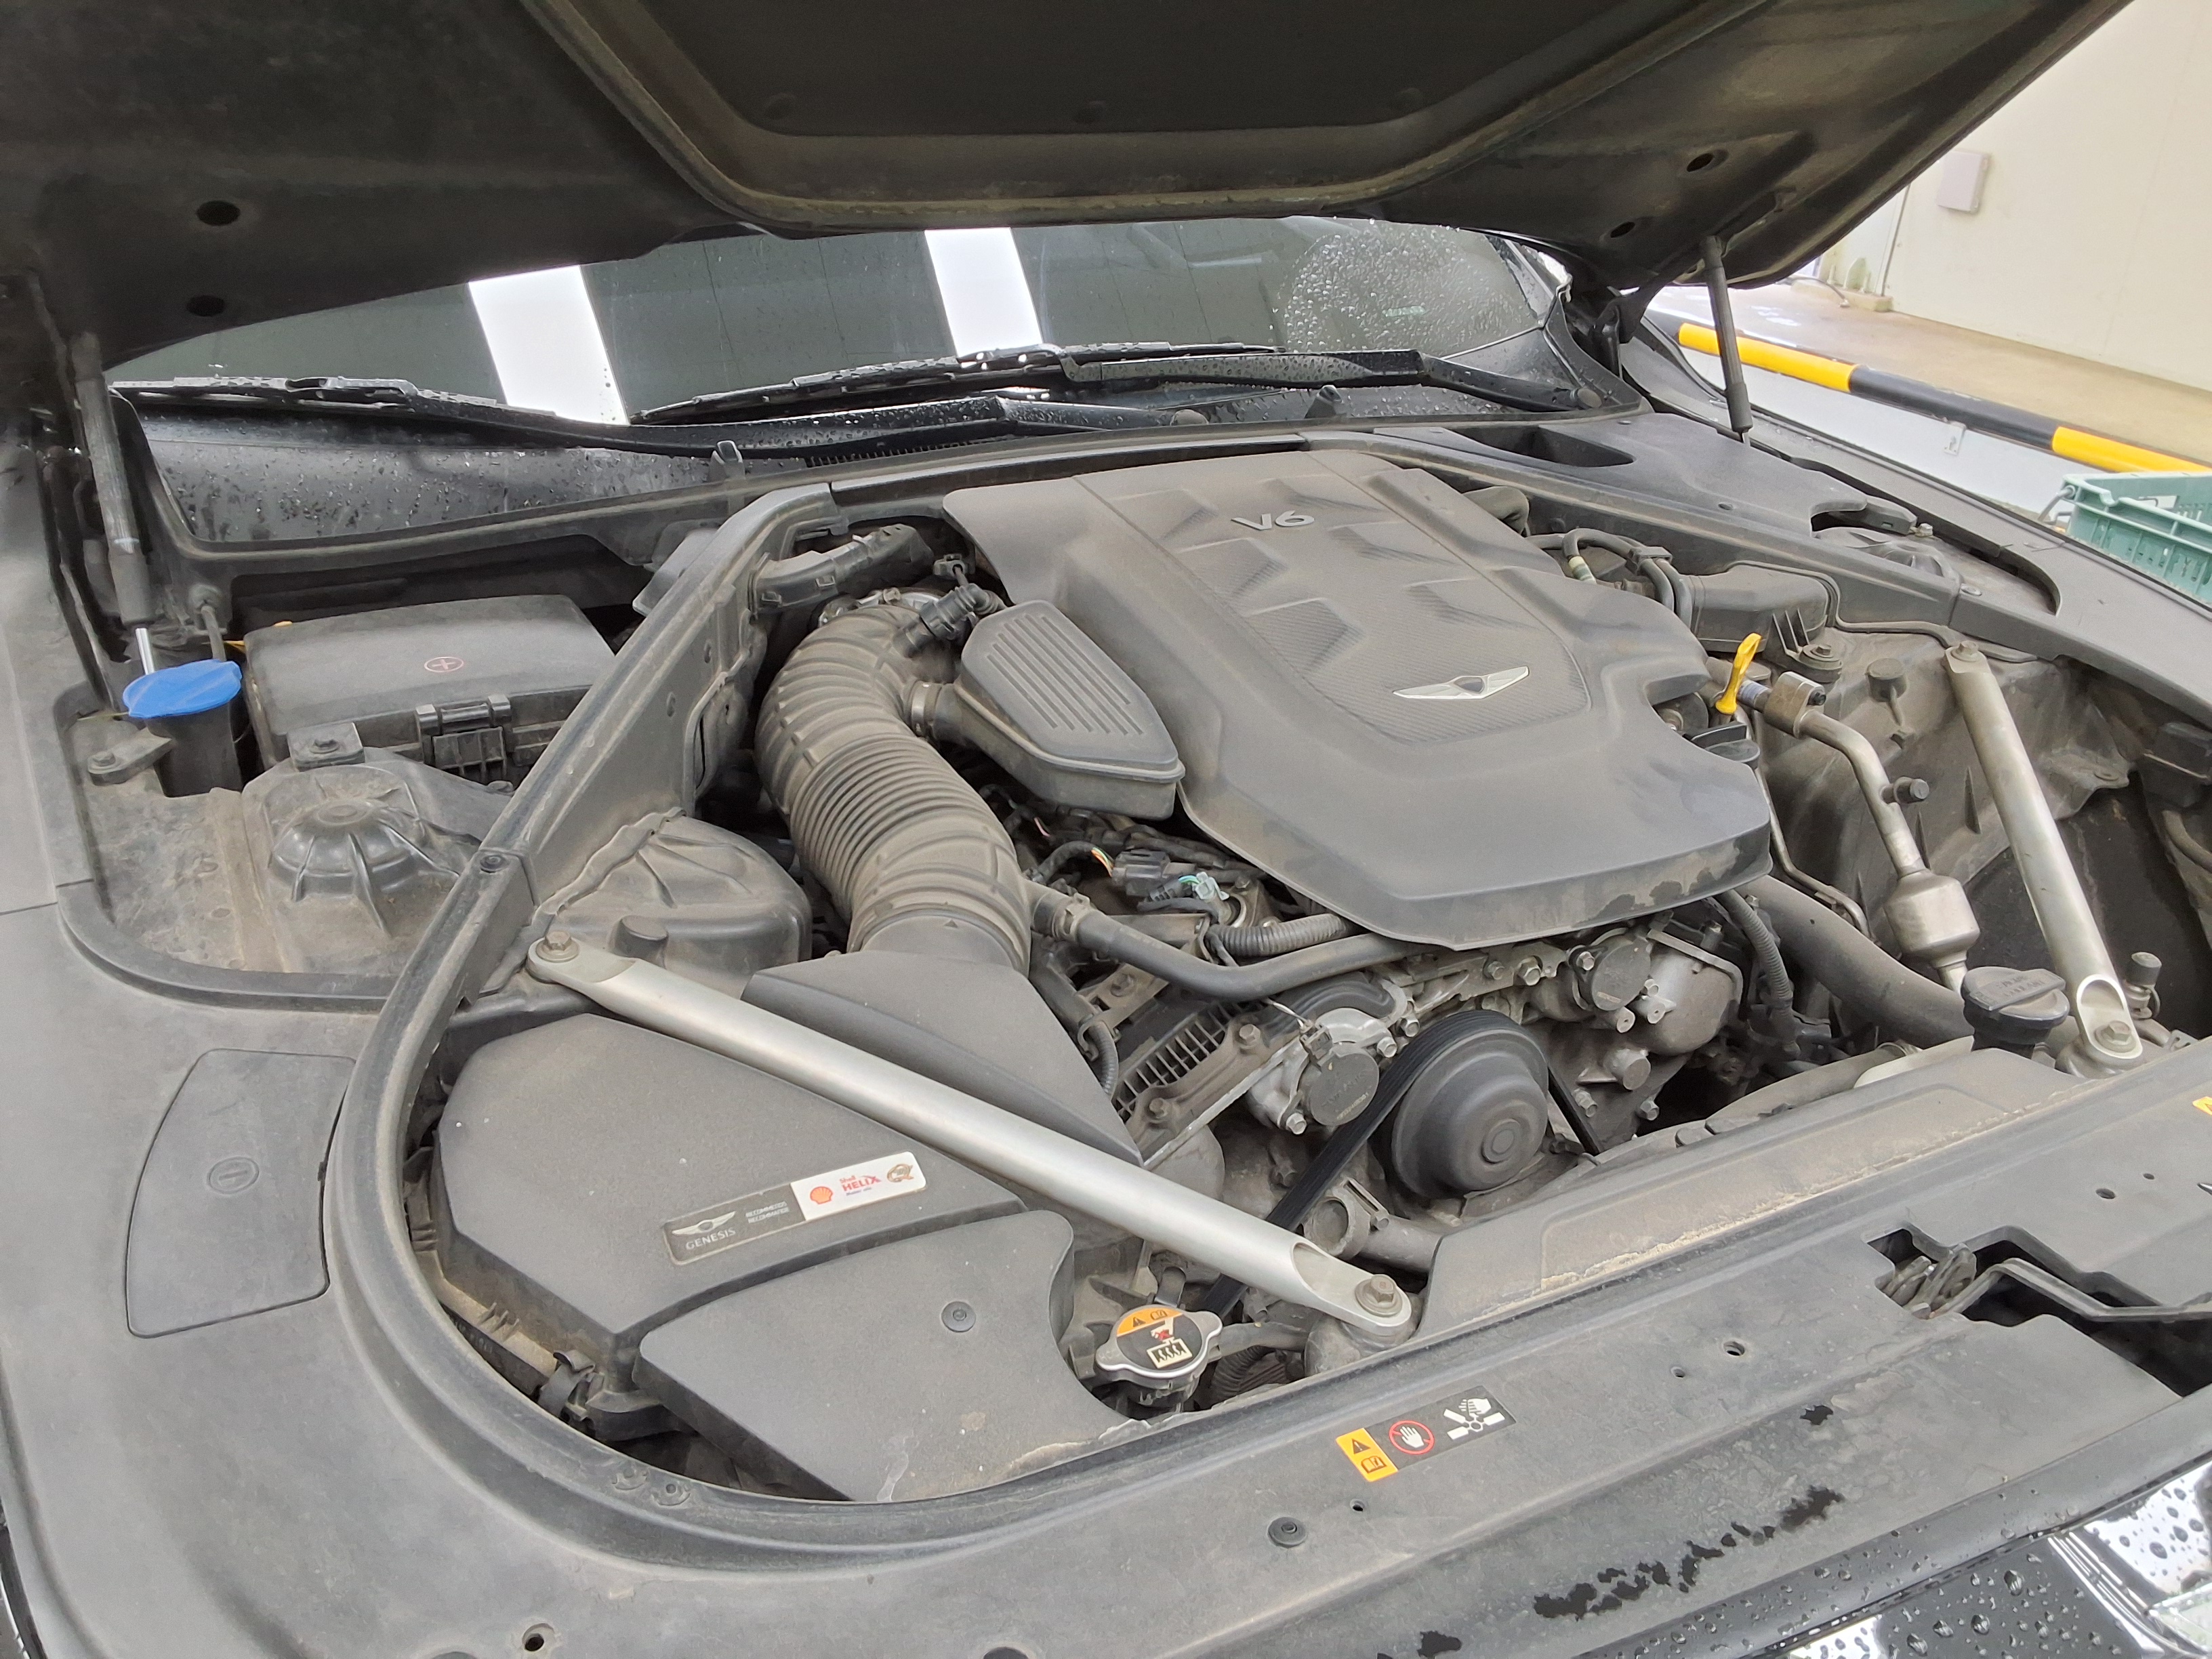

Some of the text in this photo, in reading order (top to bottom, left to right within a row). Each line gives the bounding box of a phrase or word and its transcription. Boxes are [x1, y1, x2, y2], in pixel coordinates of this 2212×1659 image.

[1230, 510, 1315, 531] V6
[842, 1176, 881, 1191] HELIX
[685, 1228, 736, 1250] GENESIS
